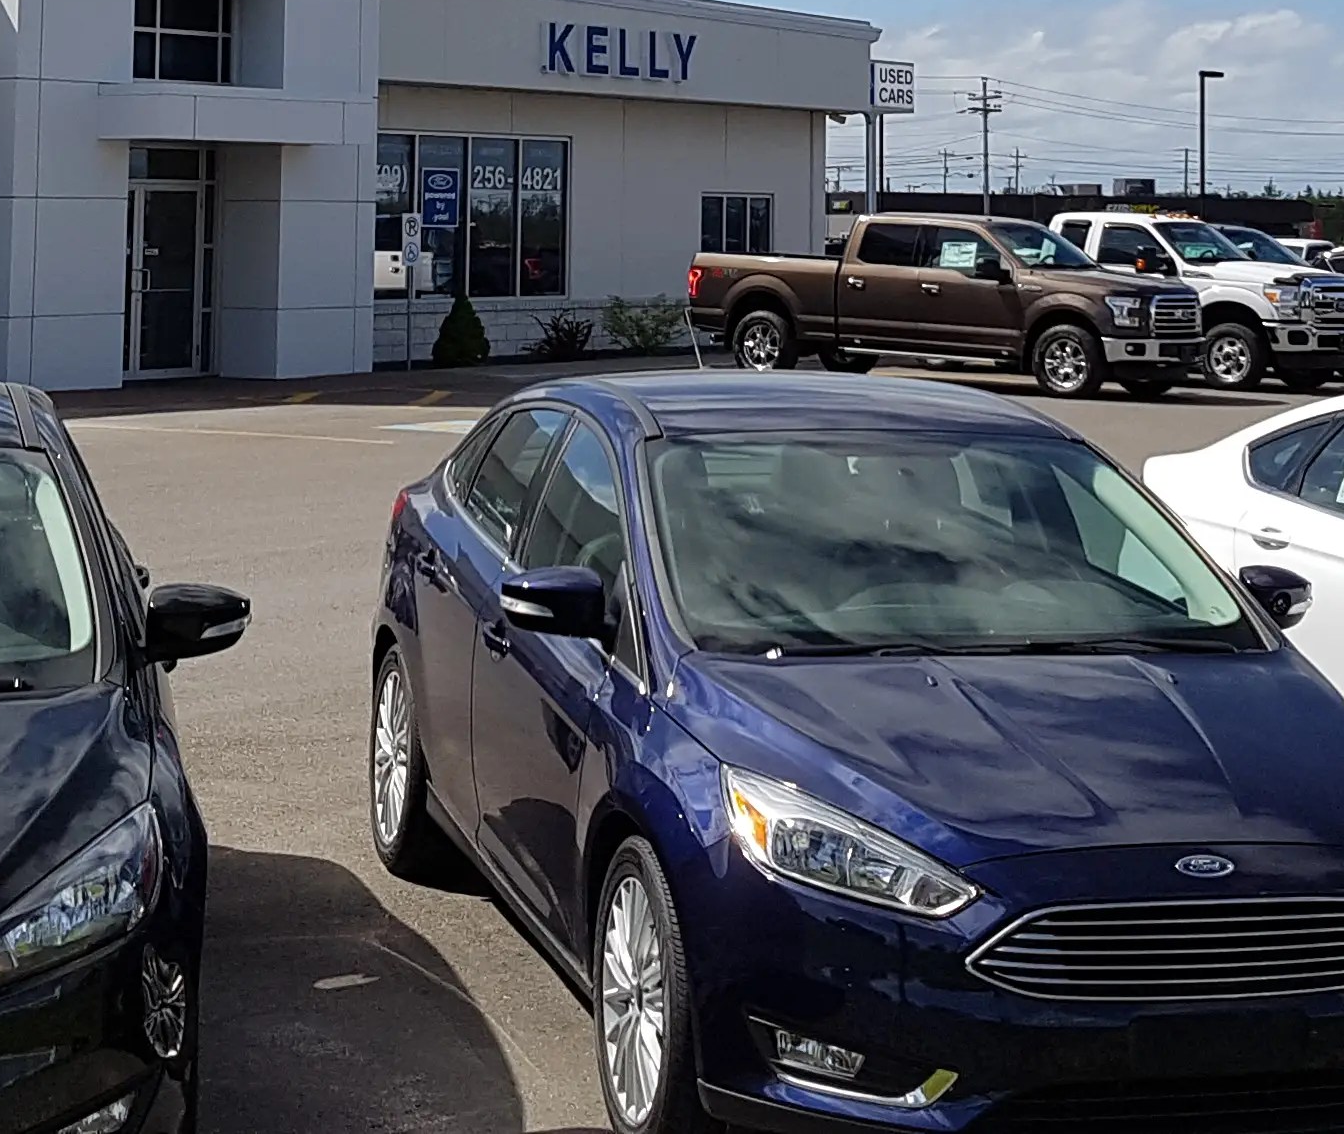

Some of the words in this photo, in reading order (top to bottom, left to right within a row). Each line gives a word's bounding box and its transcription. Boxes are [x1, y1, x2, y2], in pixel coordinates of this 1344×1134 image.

[547, 22, 697, 81] KELLY
[879, 67, 913, 85] USED
[878, 87, 914, 105] CARS
[522, 167, 561, 191] 4821
